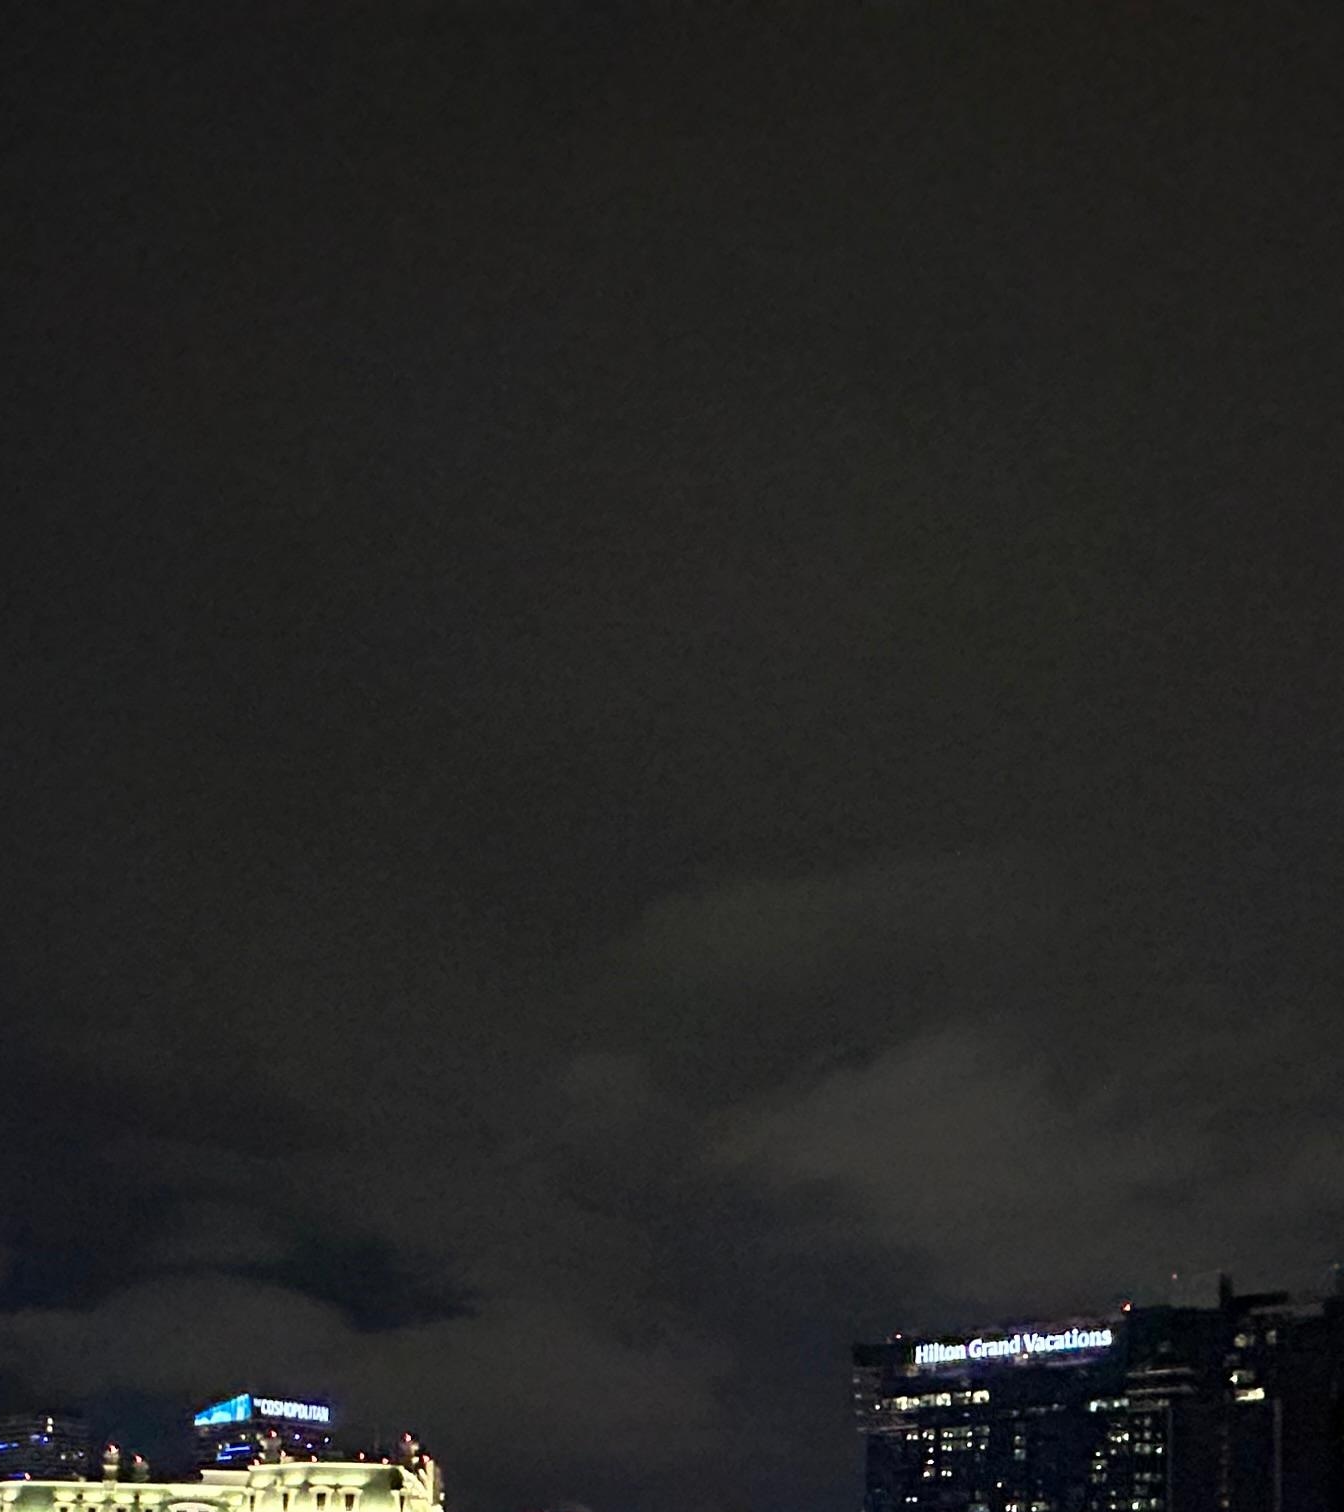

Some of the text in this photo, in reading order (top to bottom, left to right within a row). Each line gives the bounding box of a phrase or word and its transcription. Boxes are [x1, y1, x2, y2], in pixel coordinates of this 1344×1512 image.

[915, 1328, 1113, 1365] Hilton Grand Vacations
[260, 1398, 330, 1422] COSMOPOLITAN
